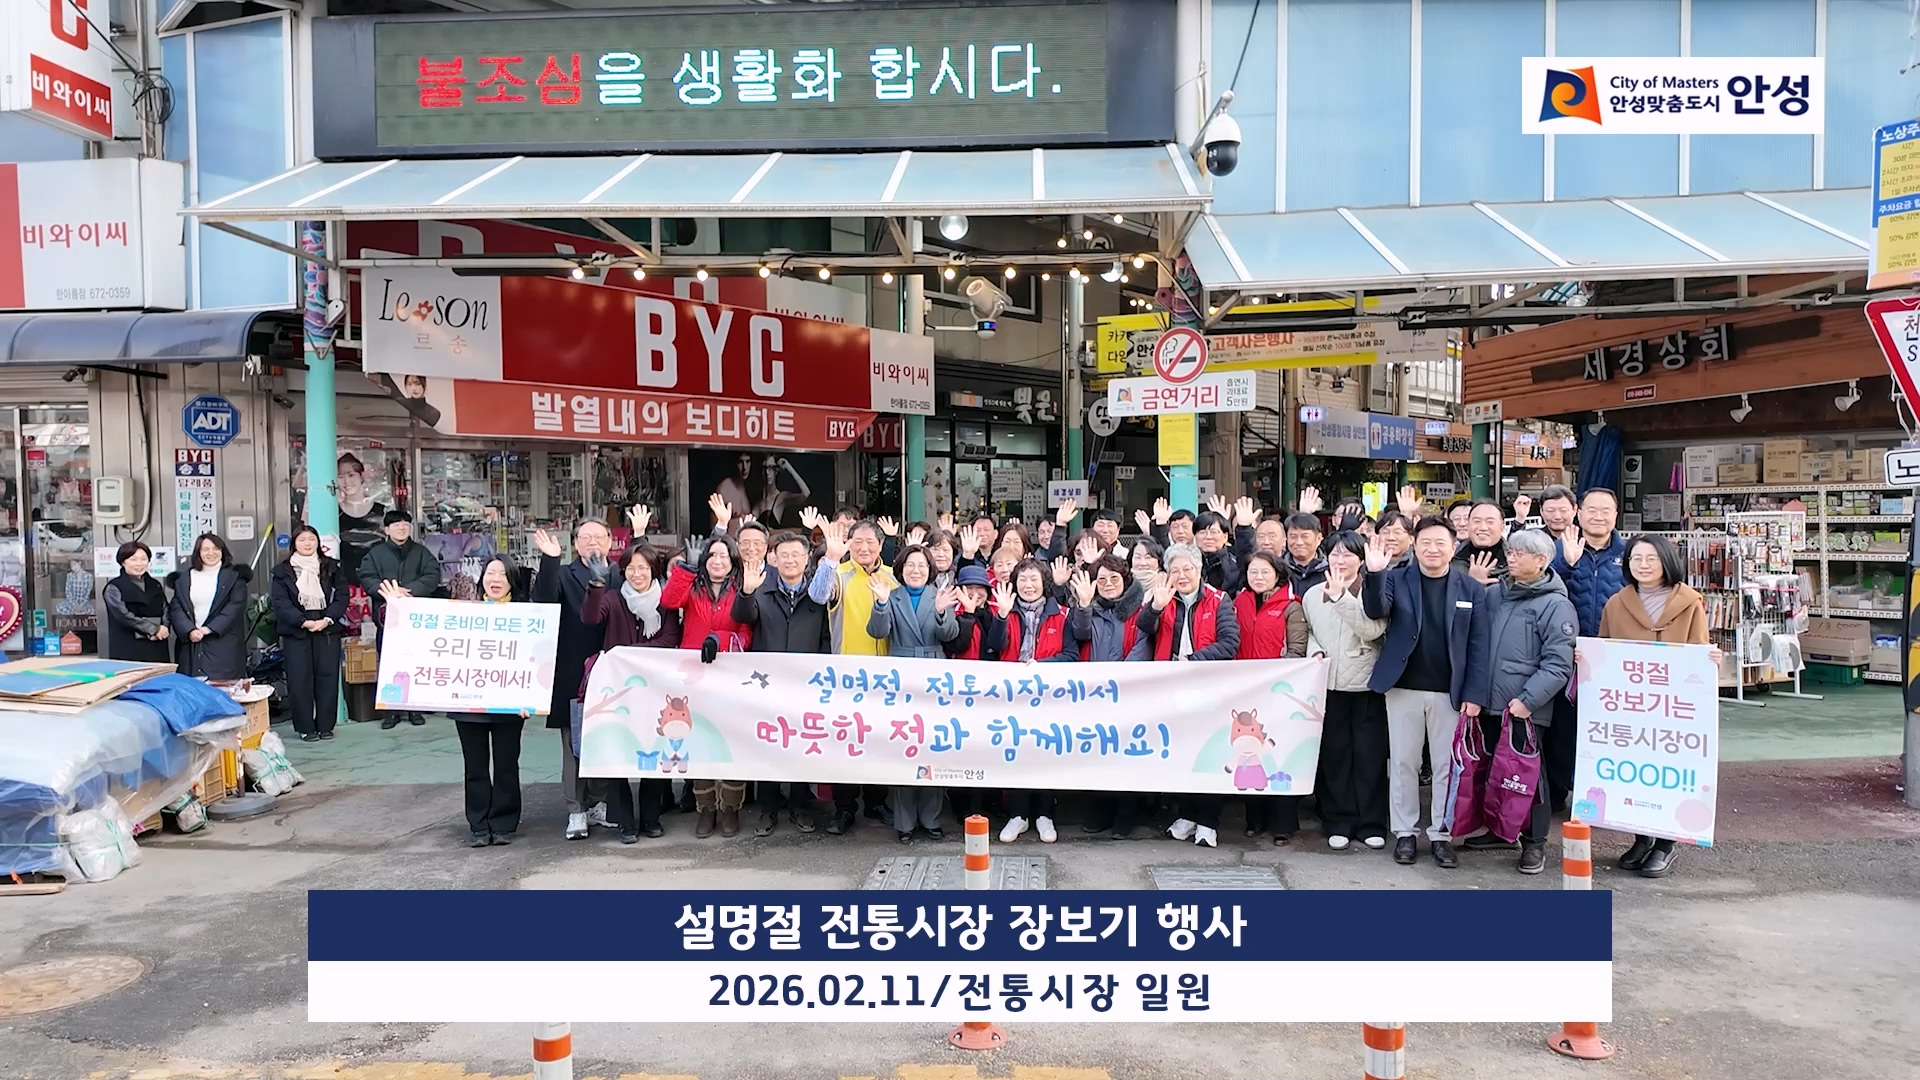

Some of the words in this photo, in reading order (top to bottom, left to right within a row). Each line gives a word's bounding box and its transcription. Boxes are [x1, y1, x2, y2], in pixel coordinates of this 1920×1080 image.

[416, 51, 645, 109] 불조심을
[672, 48, 842, 106] 생활화
[868, 43, 1064, 101] 합시다.
[31, 70, 111, 124] 비와이씨
[22, 221, 128, 249] 비와이씨
[90, 286, 131, 300] 672-0359
[634, 295, 785, 398] BYC
[1212, 333, 1295, 352] 고객사은행사
[1583, 322, 1730, 382] 세경상회
[872, 361, 929, 387] 비와이씨
[1141, 384, 1219, 411] 금연거리
[193, 411, 231, 432] ADT
[530, 390, 672, 436] 발열내의
[685, 402, 796, 442] 보디히트
[829, 420, 856, 438] BYC
[178, 448, 212, 462] BYC
[409, 612, 439, 630] 명절
[444, 615, 489, 632] 준비의
[493, 617, 523, 634] 모든
[527, 618, 546, 634] 것!
[429, 637, 471, 659] 우리
[477, 639, 518, 661] 동네
[413, 666, 532, 690] 전통시장에서!
[808, 666, 913, 706] 설명절,
[926, 672, 1120, 708] 전통시장에서
[1622, 660, 1670, 687] 명절
[1599, 688, 1697, 720] 장보기는
[756, 711, 873, 757] 따뜻한
[889, 713, 970, 758] 정과
[986, 715, 1171, 762] 함께해요!
[1587, 720, 1709, 758] 전통시장이
[964, 769, 984, 780] 안성
[1595, 757, 1696, 793] GOOD!!
